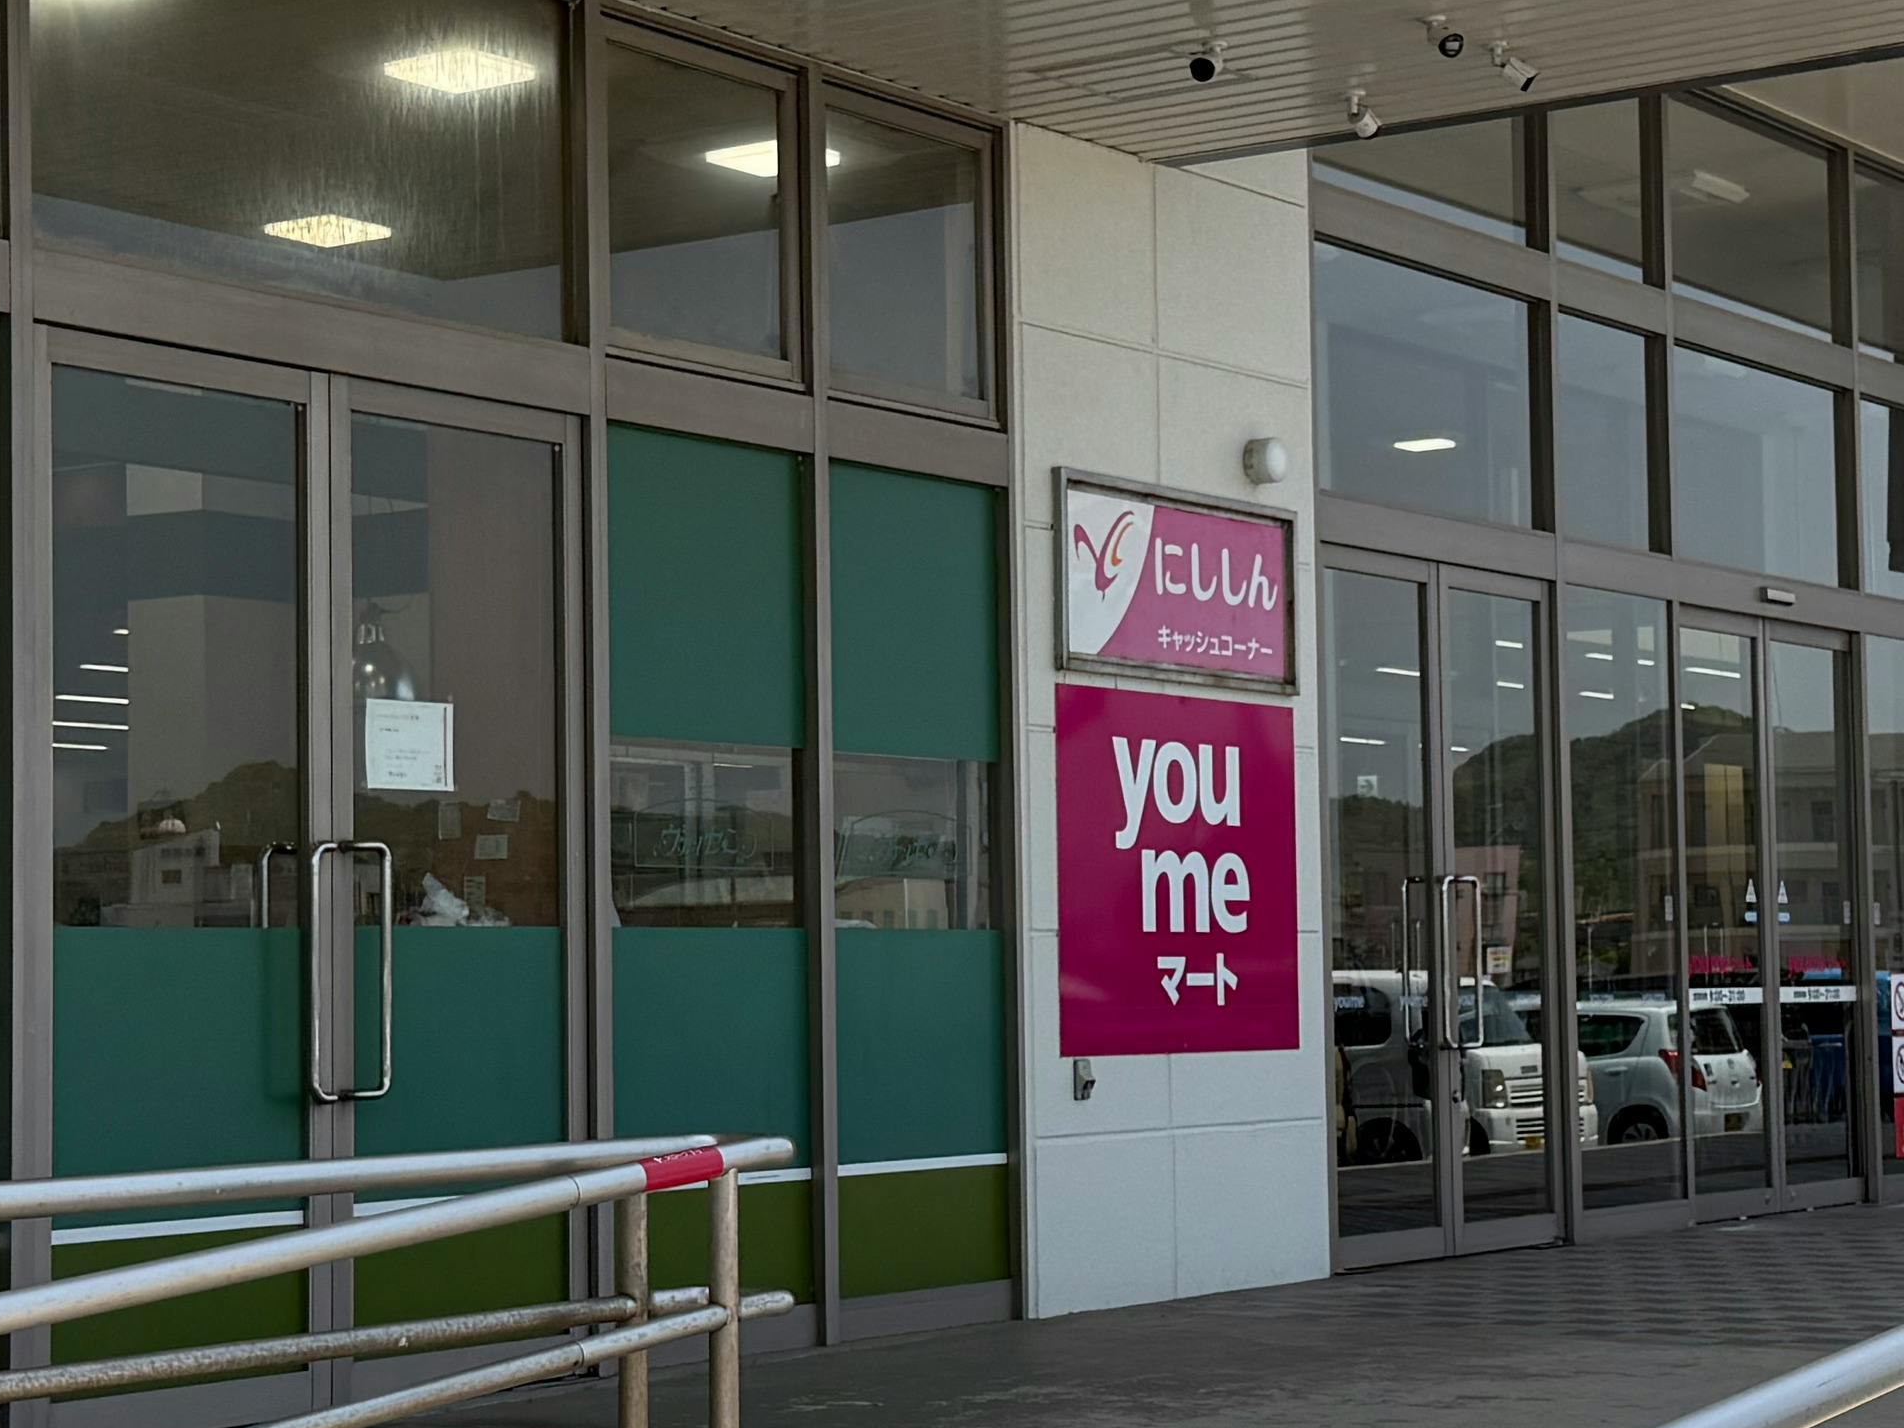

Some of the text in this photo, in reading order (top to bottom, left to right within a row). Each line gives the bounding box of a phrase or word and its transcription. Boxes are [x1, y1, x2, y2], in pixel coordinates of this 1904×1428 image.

[1154, 536, 1278, 613] にししん
[1157, 625, 1274, 661] キャッシュコーナー
[1112, 736, 1241, 849] you
[1142, 850, 1250, 933] me
[1157, 953, 1238, 1006] マート
